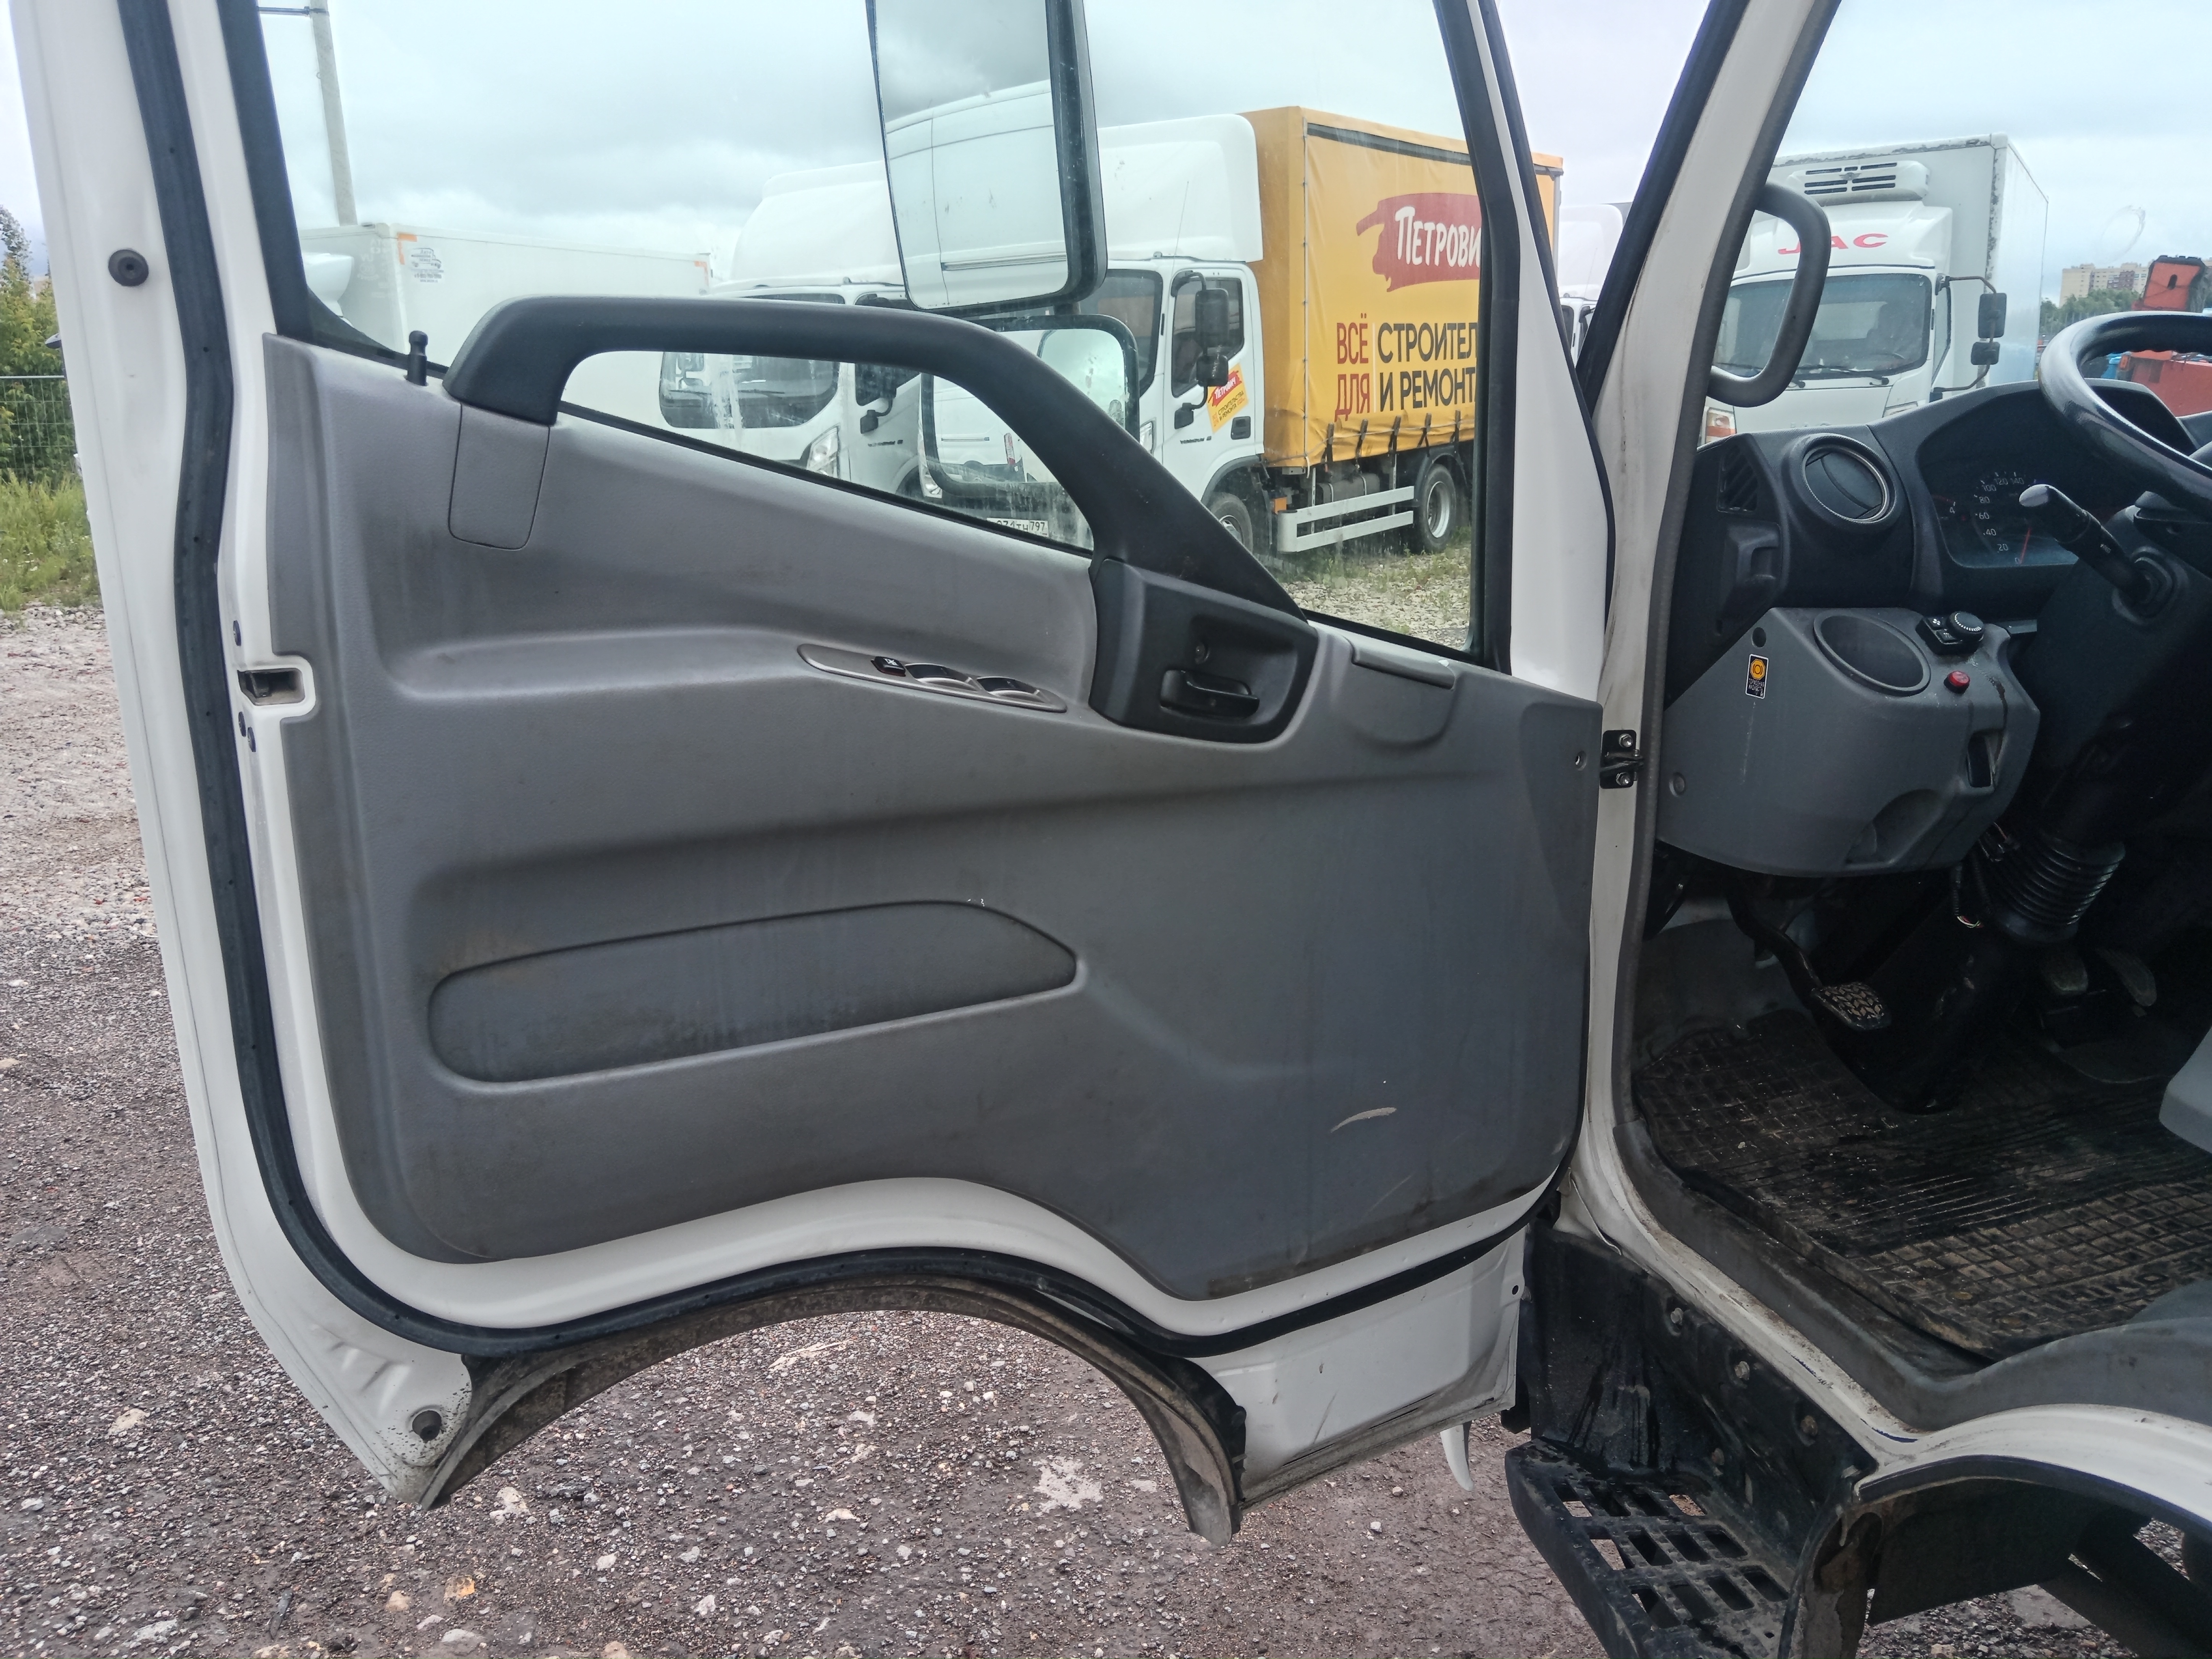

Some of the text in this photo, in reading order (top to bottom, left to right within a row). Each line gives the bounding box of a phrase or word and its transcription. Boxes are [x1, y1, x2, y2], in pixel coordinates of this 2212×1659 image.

[1337, 313, 1369, 364] ВСЁ
[1378, 322, 1478, 364] СТРОИТЕЛ
[1334, 373, 1370, 422] ДЛЯ
[1379, 367, 1476, 412] И РЕМОНТ
[1030, 521, 1045, 531] 797
